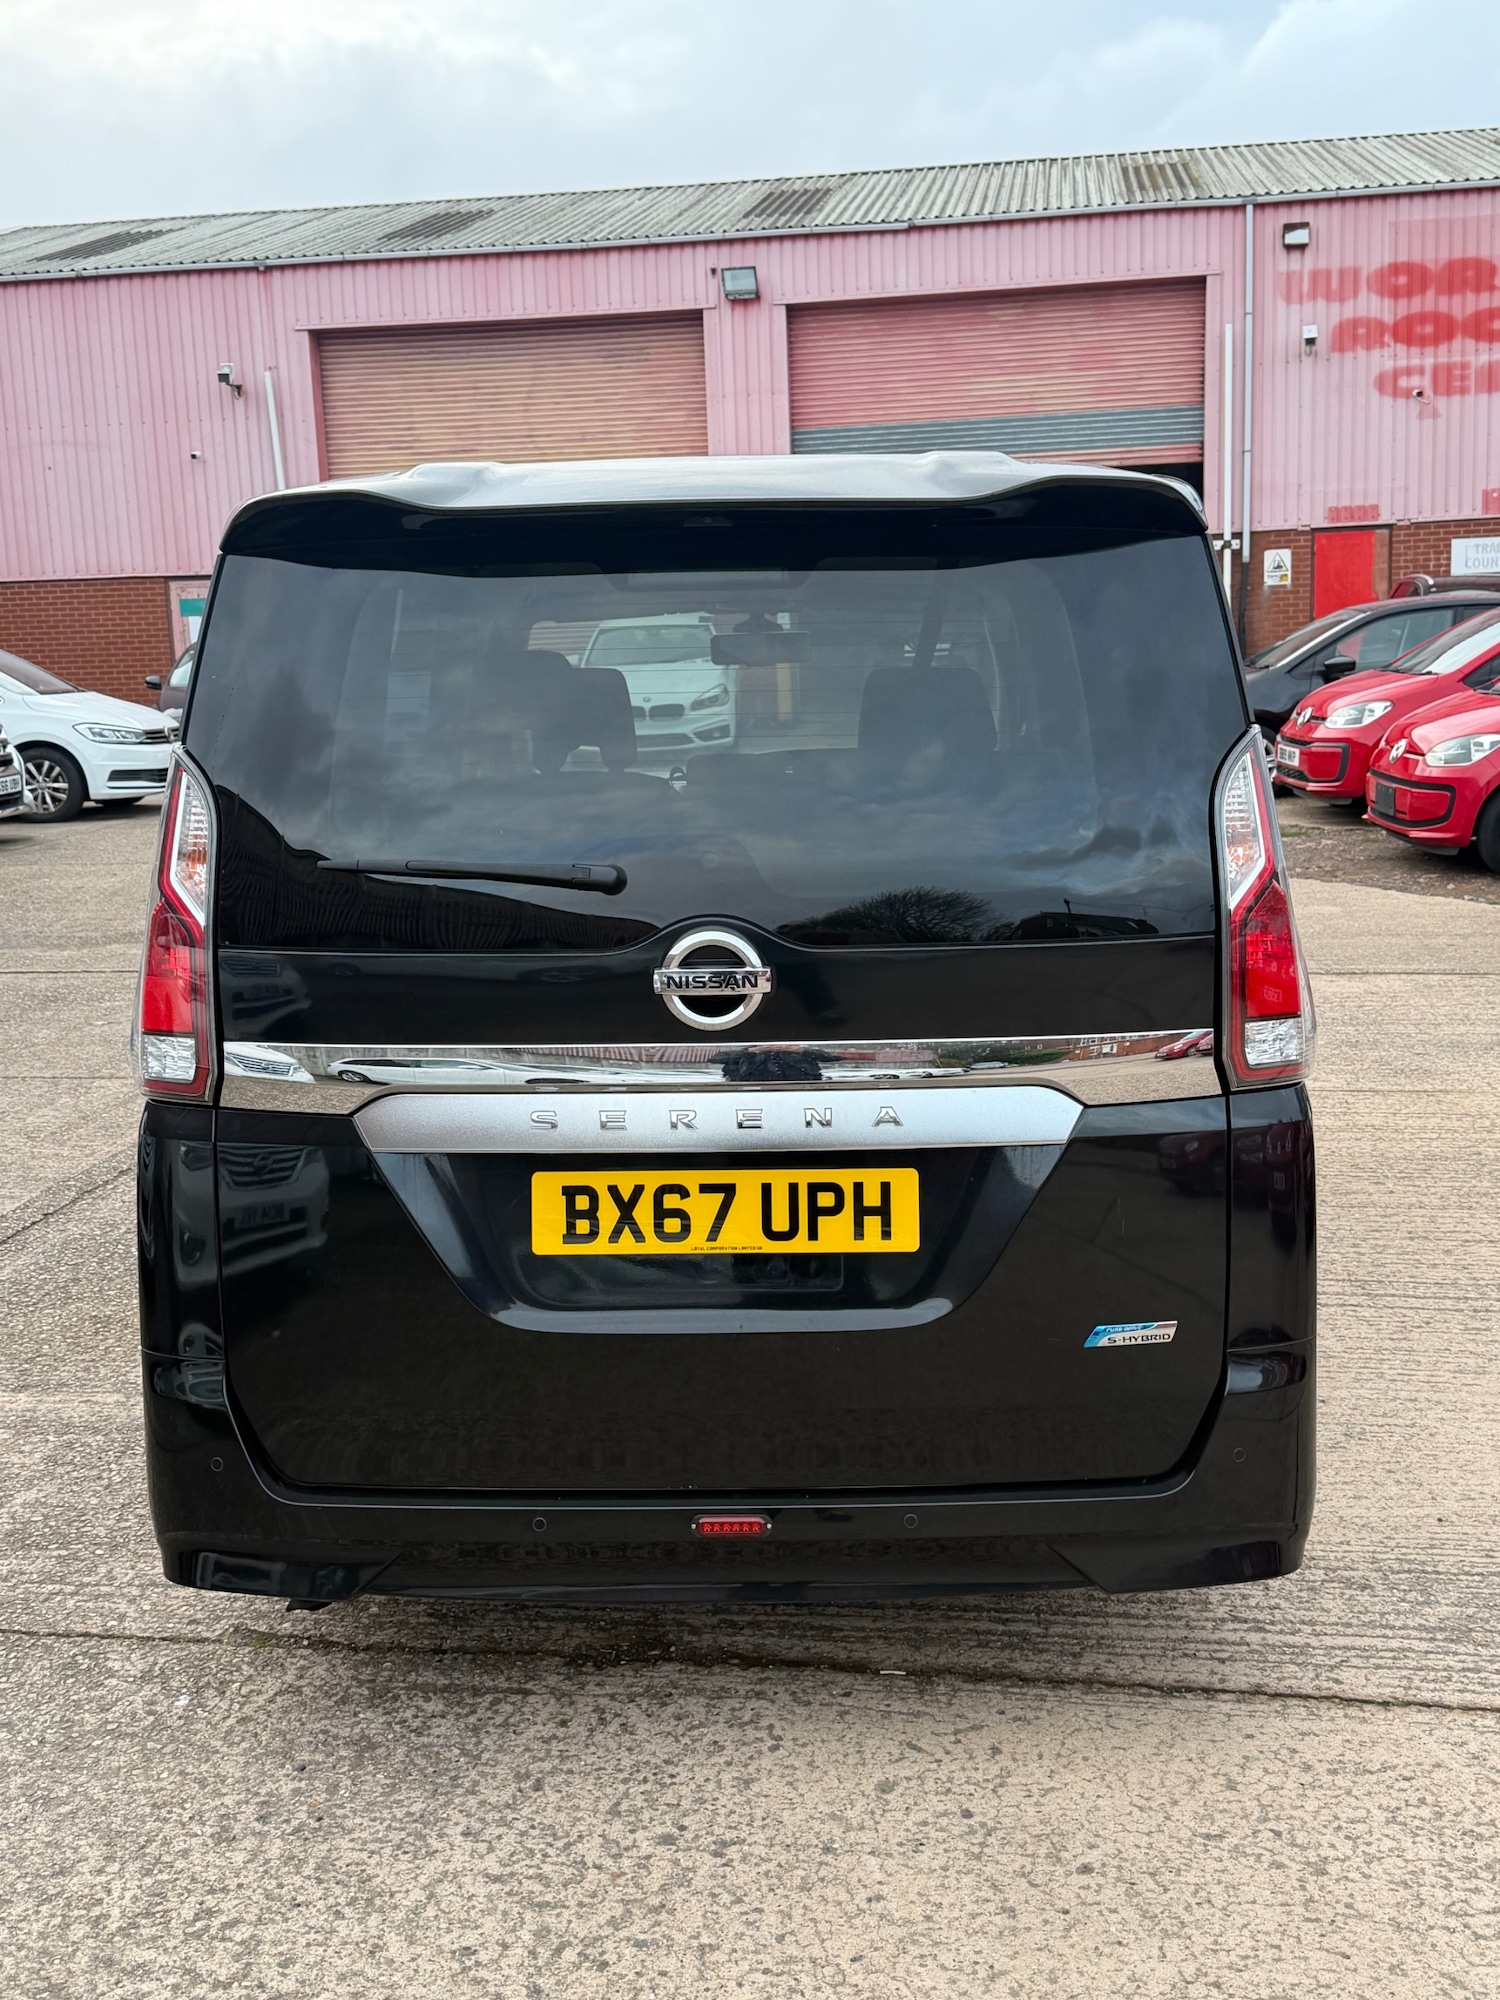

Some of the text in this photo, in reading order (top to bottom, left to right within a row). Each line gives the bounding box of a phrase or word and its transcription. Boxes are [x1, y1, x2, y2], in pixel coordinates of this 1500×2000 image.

[665, 974, 759, 990] NISSAN
[529, 1106, 904, 1131] SERENA
[561, 1181, 892, 1245] BX67 UPH
[1107, 1333, 1171, 1344] S-HYBRID
